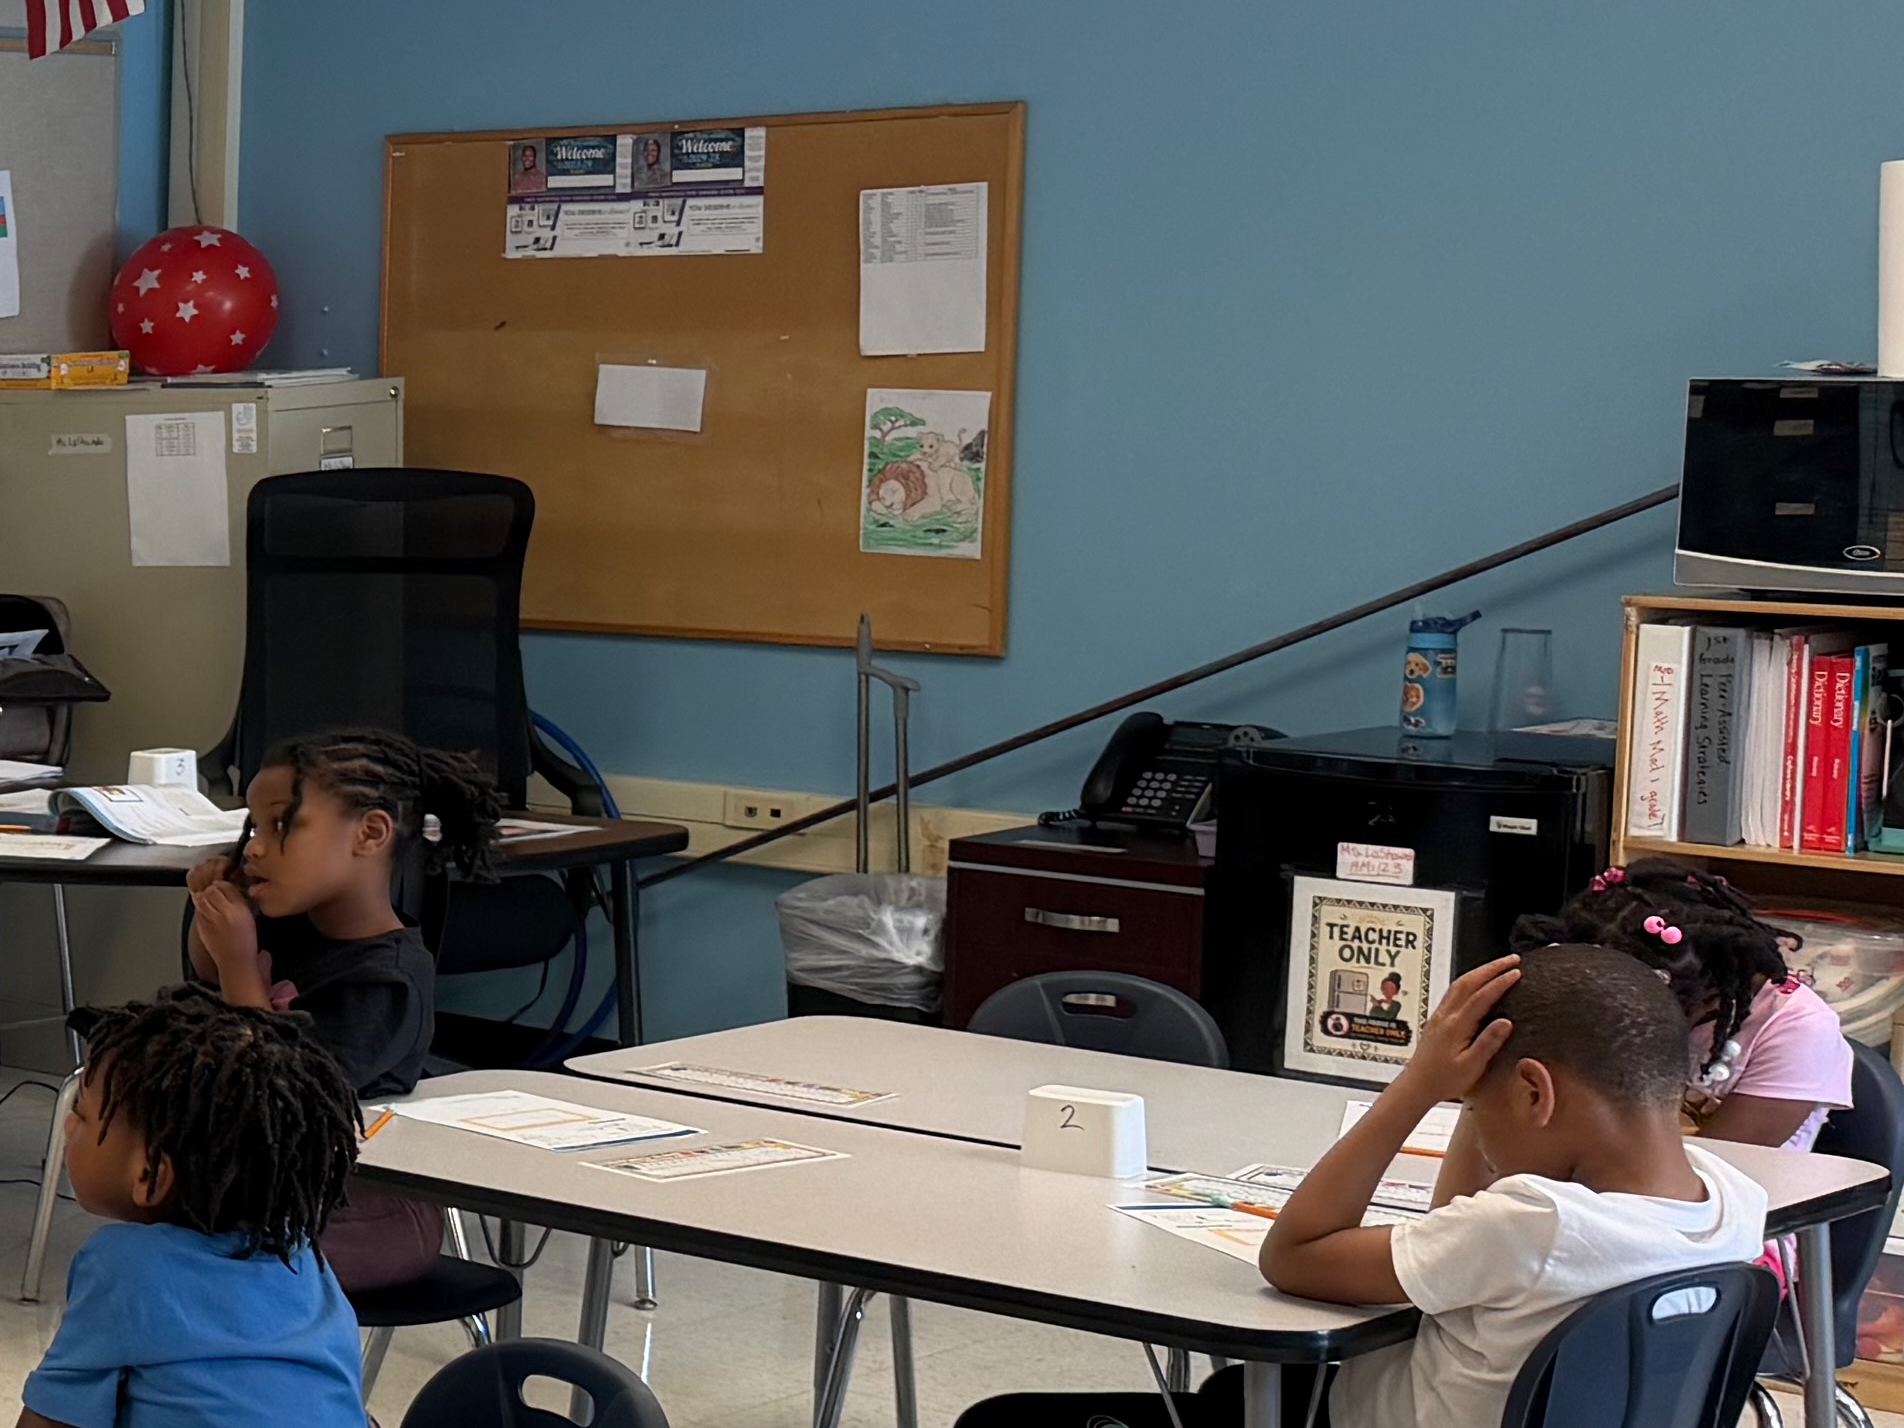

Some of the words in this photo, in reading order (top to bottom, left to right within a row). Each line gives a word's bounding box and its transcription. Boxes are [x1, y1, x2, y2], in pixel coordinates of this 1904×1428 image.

[556, 146, 605, 160] Welcome
[680, 141, 733, 153] Welcome
[1810, 671, 1828, 727] Dictionary
[1830, 673, 1850, 728] Dictionary
[1325, 922, 1417, 950] TEACHER
[1338, 944, 1401, 968] ONLY
[1058, 1103, 1085, 1130] 2
